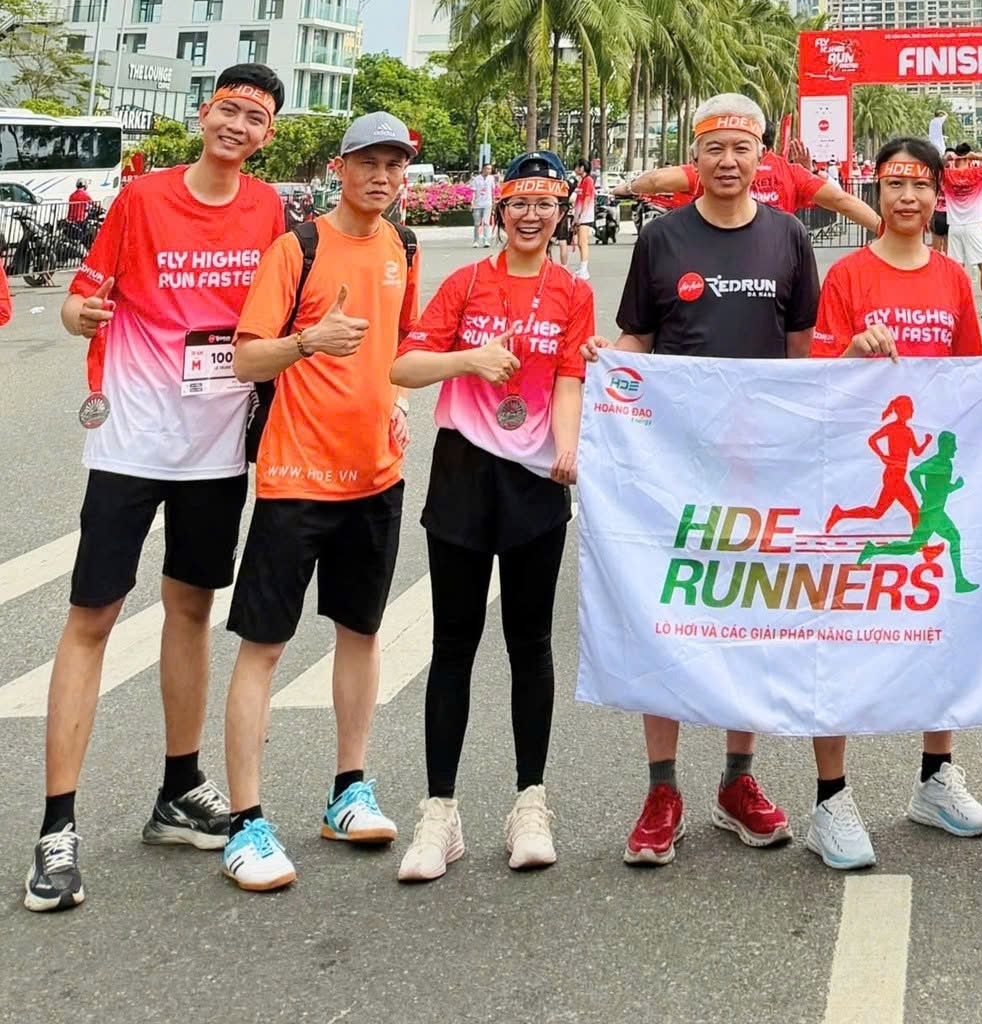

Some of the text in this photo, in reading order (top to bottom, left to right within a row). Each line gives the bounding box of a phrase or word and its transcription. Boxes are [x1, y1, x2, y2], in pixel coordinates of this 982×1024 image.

[144, 66, 172, 83] LOUNGE
[157, 249, 261, 269] FLY HIGHER
[158, 272, 195, 288] RUN
[191, 360, 201, 371] M
[610, 377, 640, 392] HDE
[594, 402, 629, 415] HOÀNG
[673, 504, 801, 553] HDE
[660, 558, 944, 612] RUNNERS
[655, 622, 942, 645] LÒ HƠI VÀ CÁC GIẢI PHÁP NĂNG LƯỢNG NHIỆT
